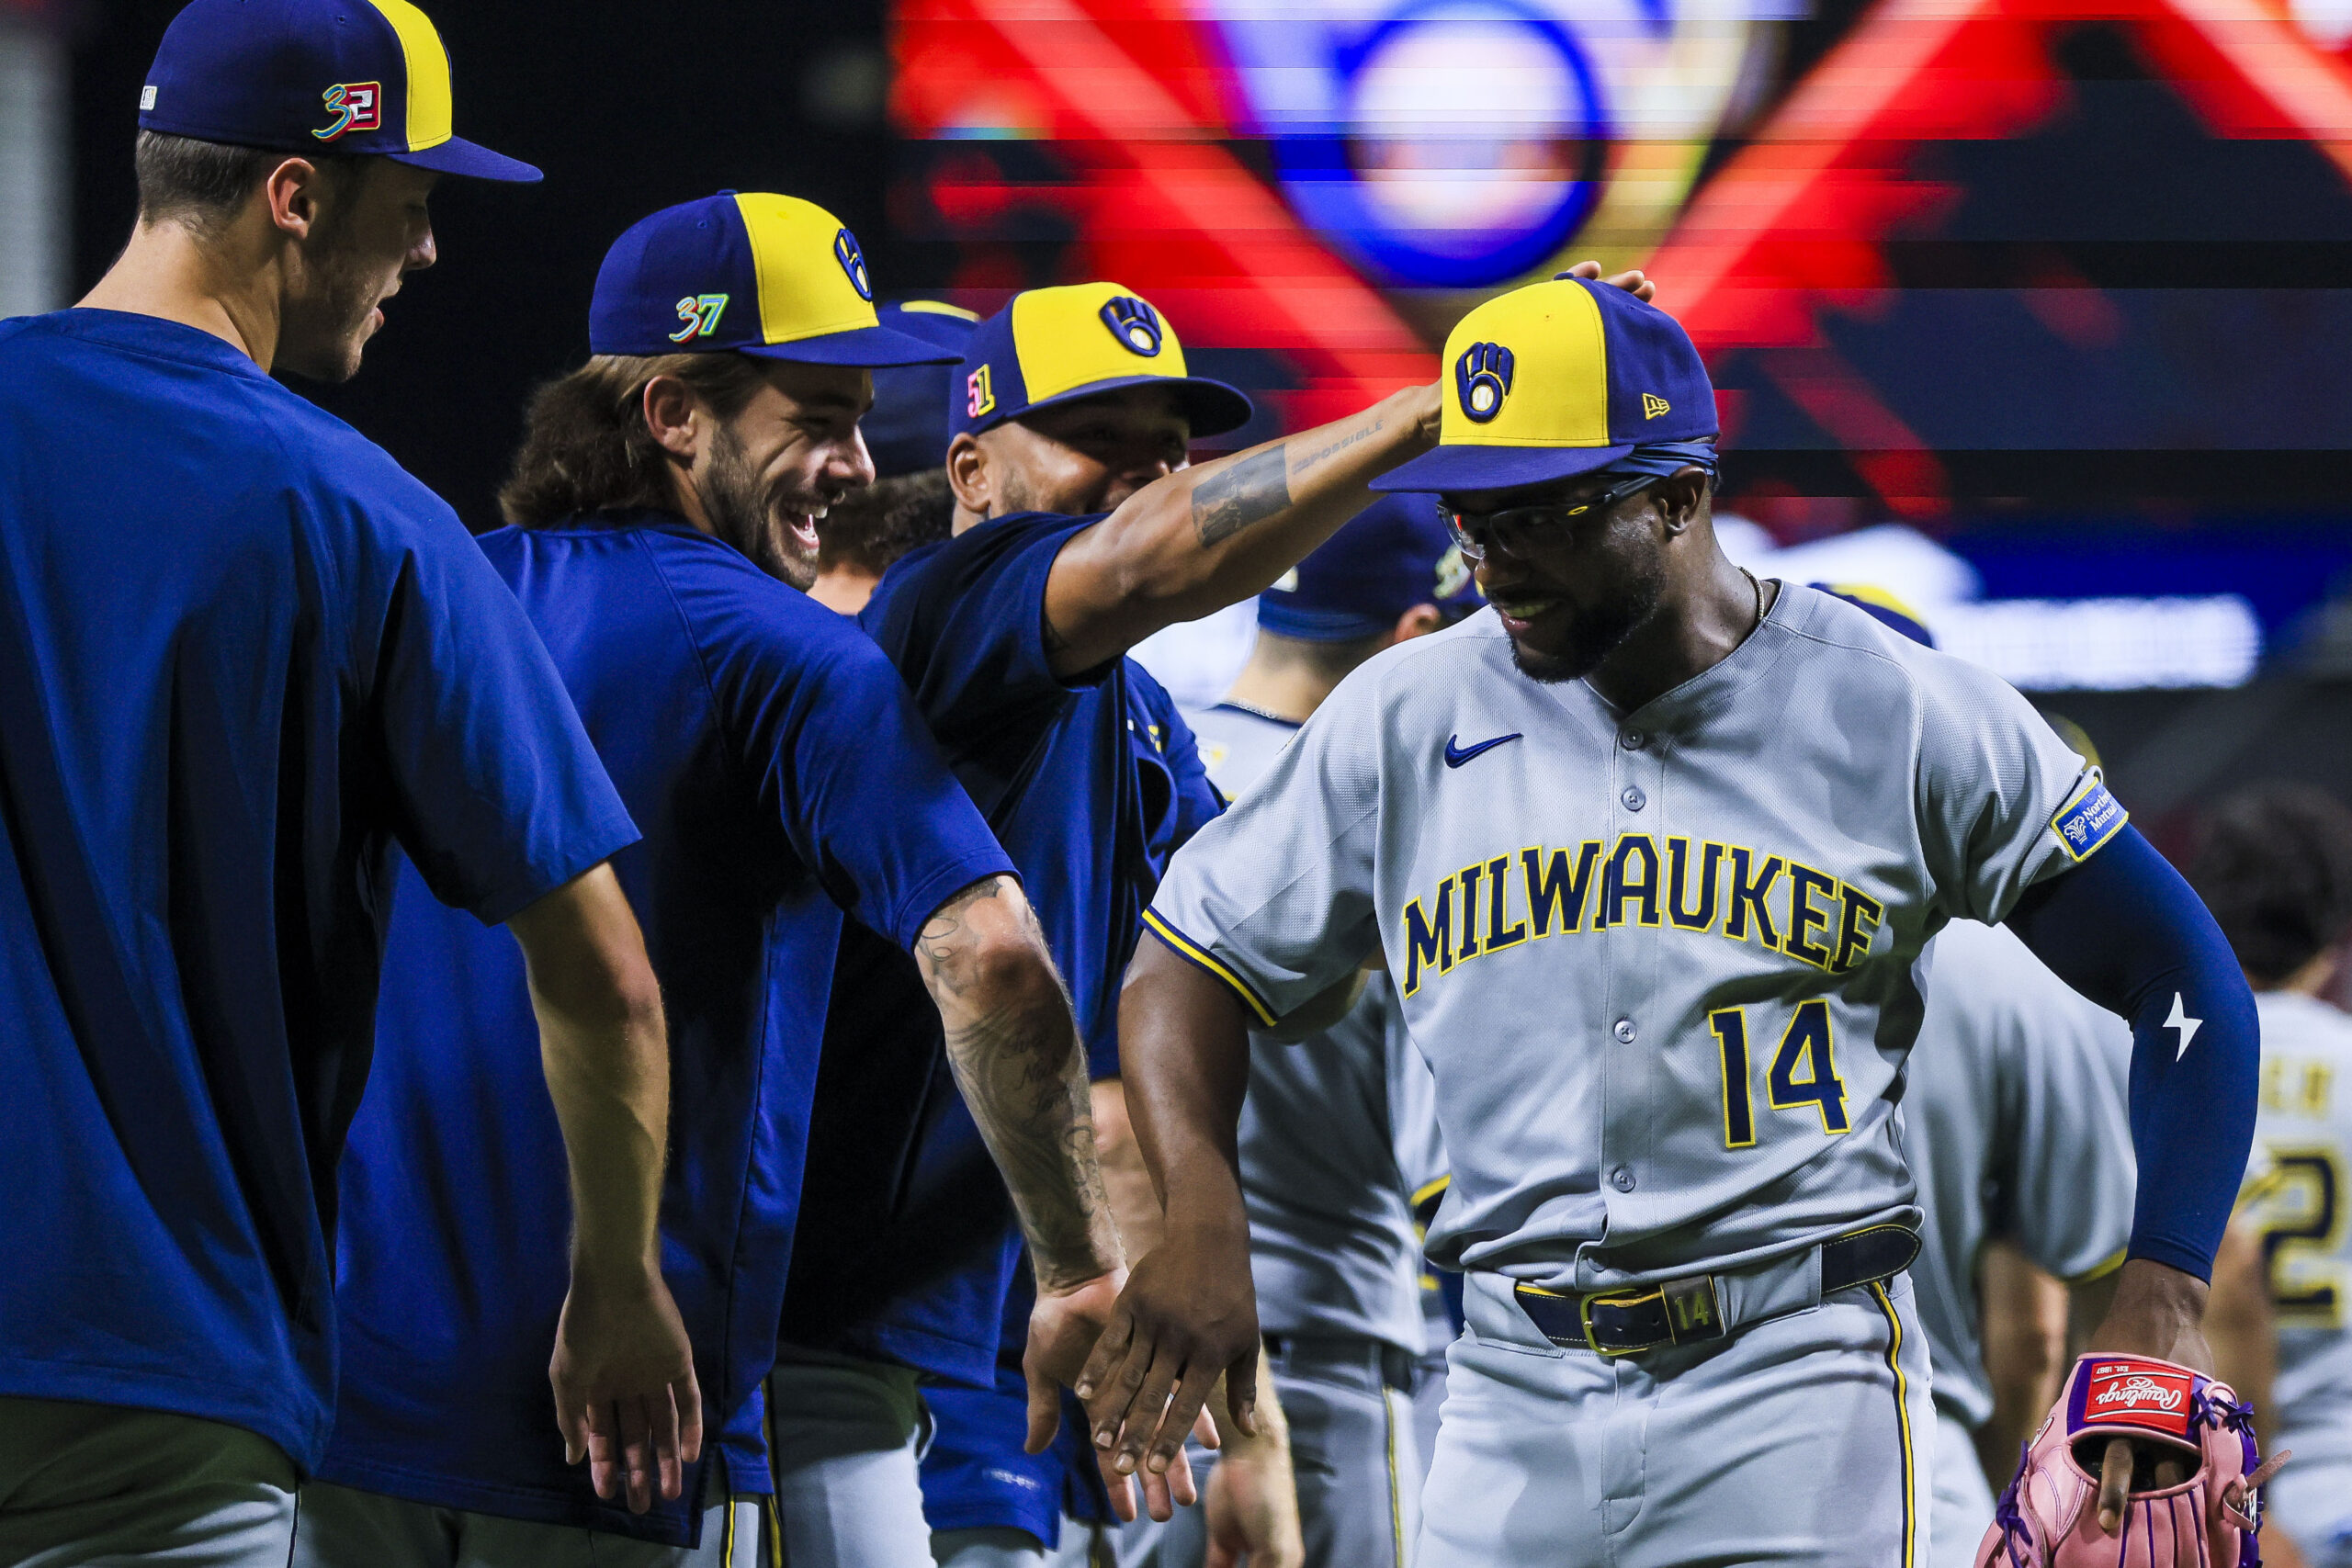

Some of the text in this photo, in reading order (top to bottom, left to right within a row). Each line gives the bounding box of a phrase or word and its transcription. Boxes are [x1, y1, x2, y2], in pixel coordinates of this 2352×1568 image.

[311, 83, 376, 139] 32
[669, 293, 729, 344] 37
[967, 364, 995, 418] 51
[2089, 800, 2118, 831] Mutual
[1402, 832, 1883, 998] MILWAUKEE
[1708, 998, 1851, 1148] 14
[1674, 1292, 1710, 1331] 14
[2096, 1365, 2129, 1375] Est. 1887
[2096, 1381, 2182, 1410] Rawlings
